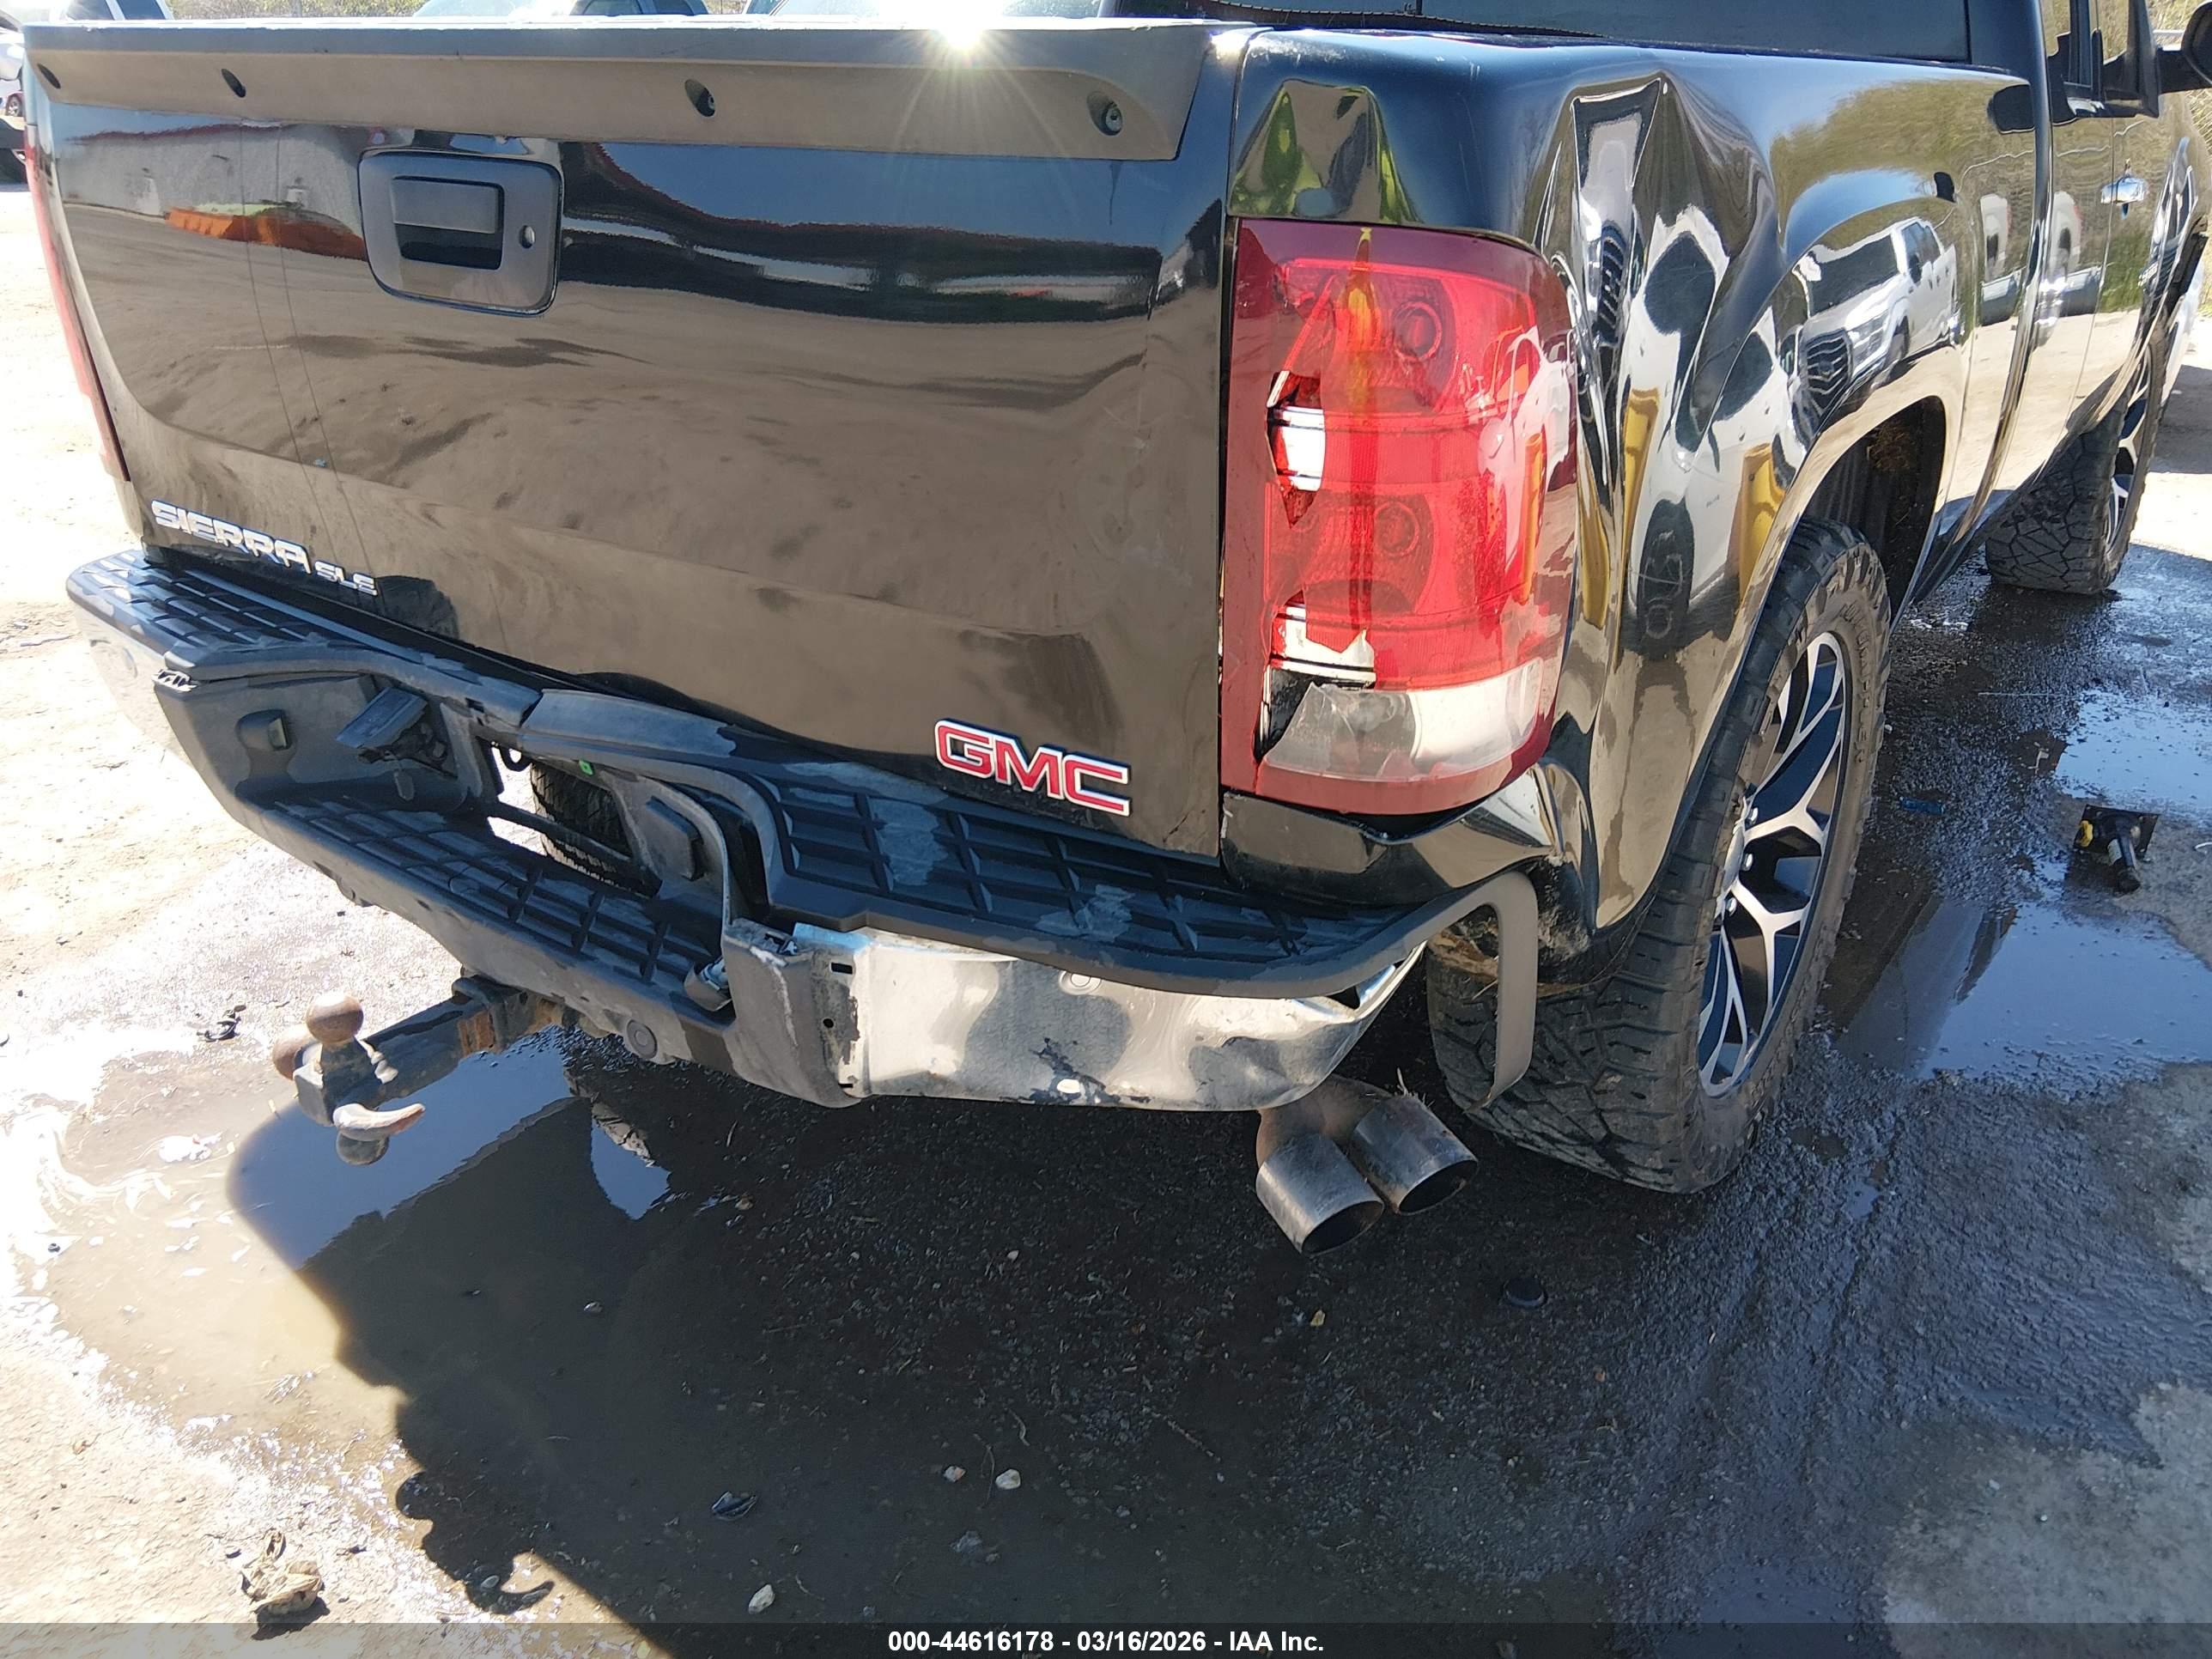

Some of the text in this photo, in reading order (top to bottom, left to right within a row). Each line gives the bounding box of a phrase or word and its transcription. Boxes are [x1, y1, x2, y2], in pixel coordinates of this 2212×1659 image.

[151, 499, 379, 597] SIERRA SLE
[934, 718, 1132, 817] GMC
